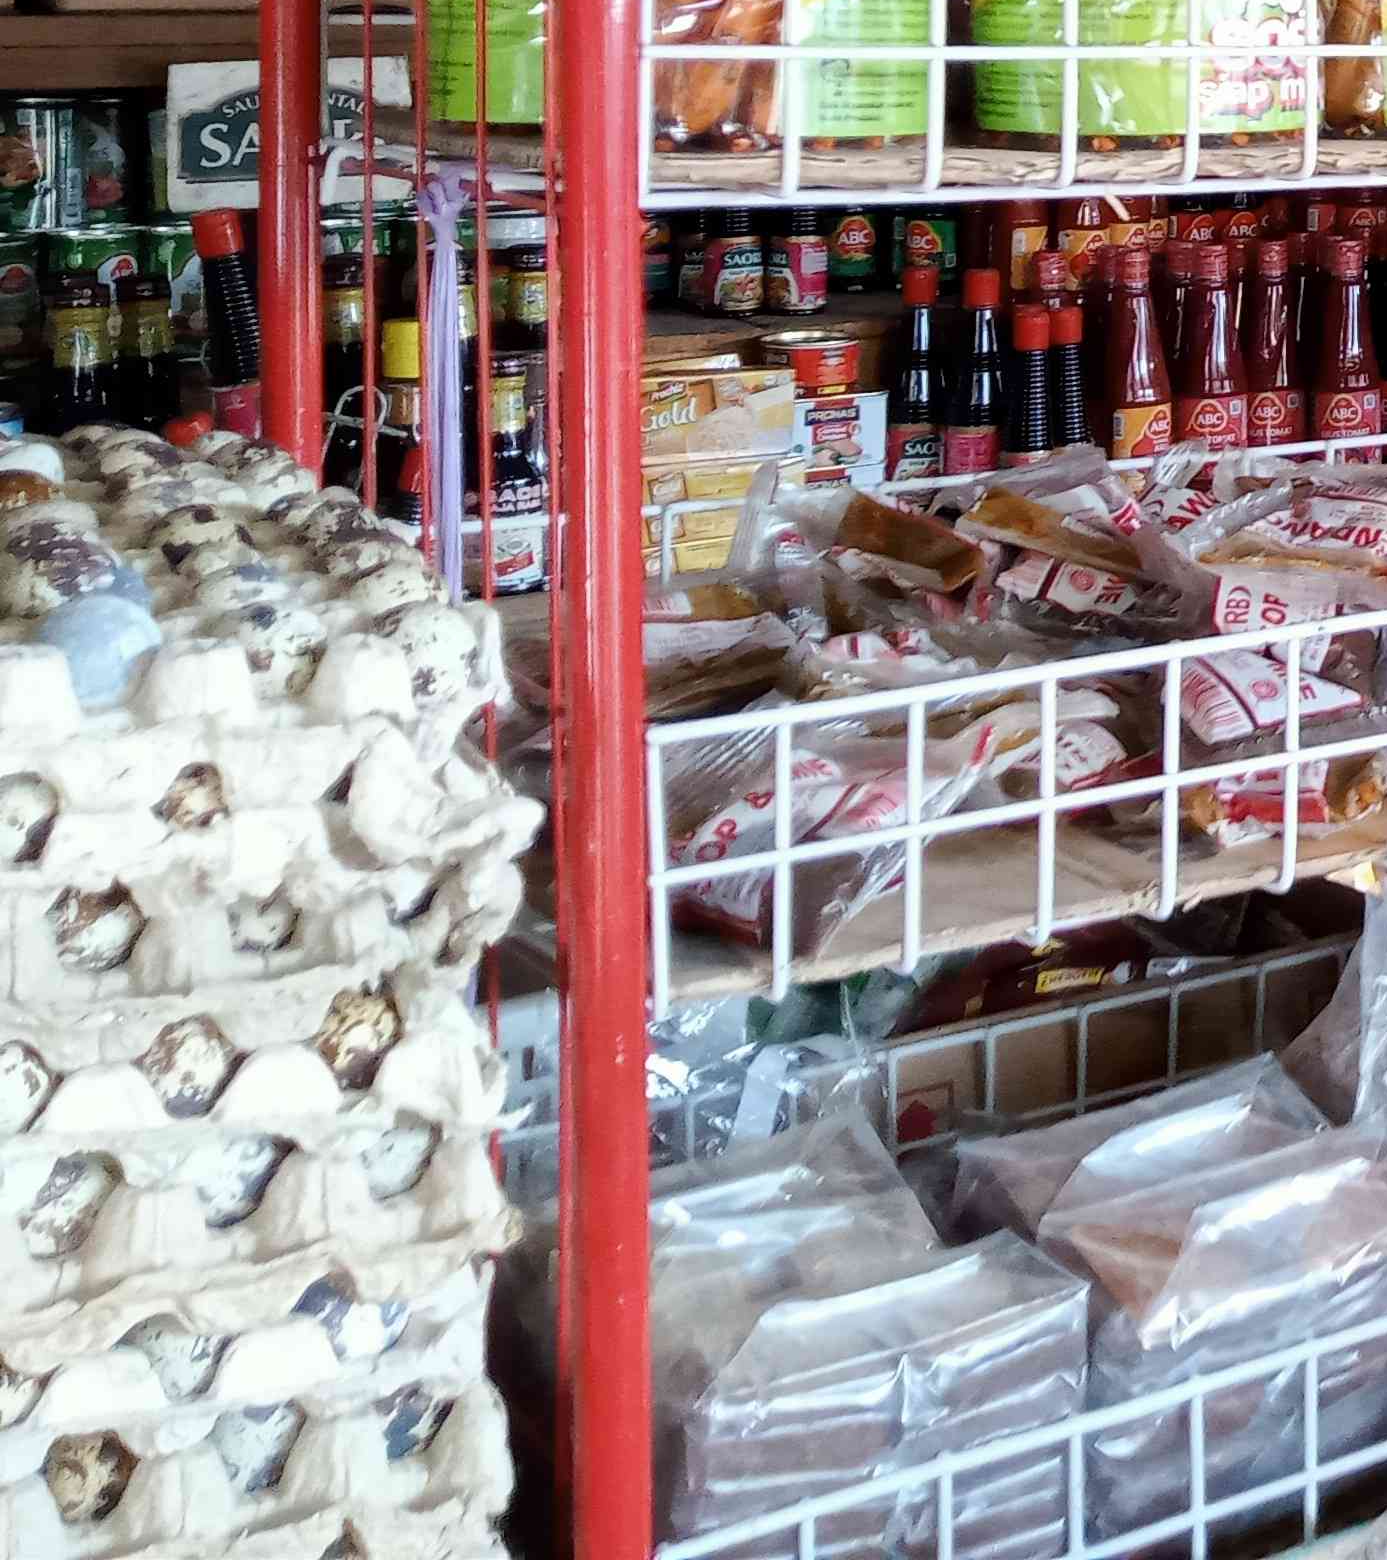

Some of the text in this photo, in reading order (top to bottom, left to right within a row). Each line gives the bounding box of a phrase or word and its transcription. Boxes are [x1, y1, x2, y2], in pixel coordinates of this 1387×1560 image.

[838, 231, 871, 246] ABC
[807, 407, 858, 423] PRONAS
[1195, 411, 1223, 426] ABC
[1254, 405, 1281, 420] ABC
[1329, 406, 1358, 421] ABC
